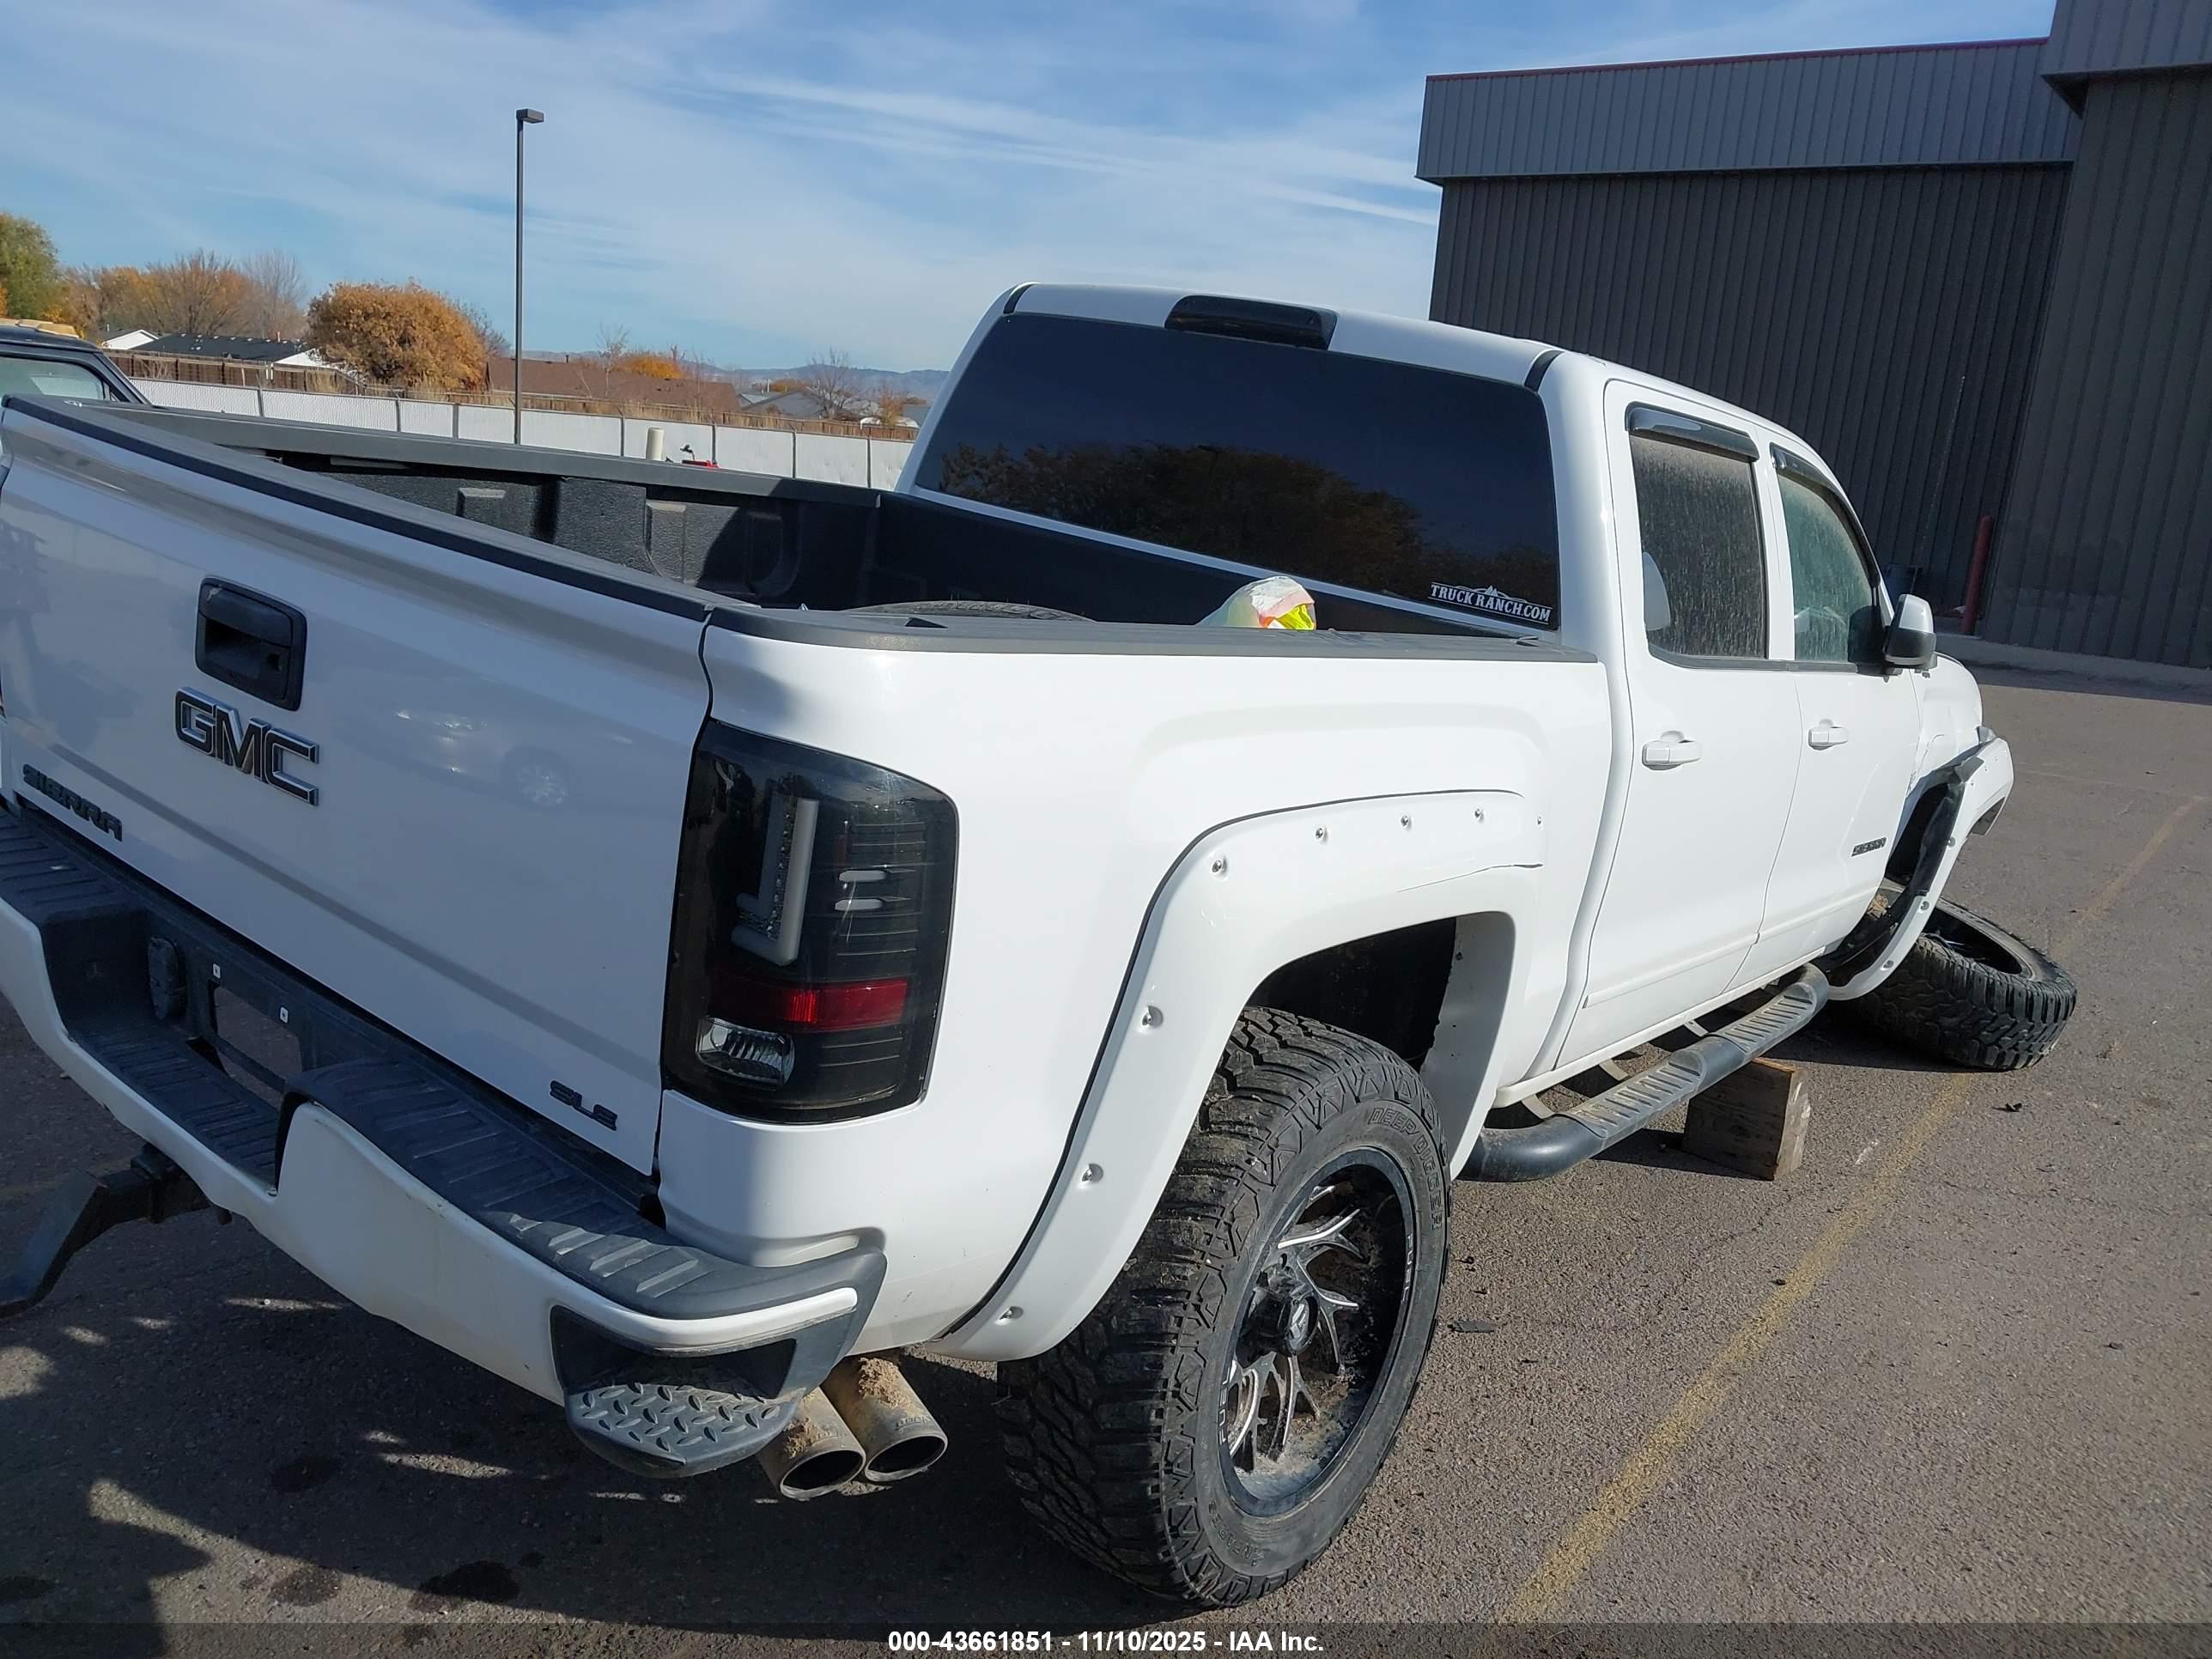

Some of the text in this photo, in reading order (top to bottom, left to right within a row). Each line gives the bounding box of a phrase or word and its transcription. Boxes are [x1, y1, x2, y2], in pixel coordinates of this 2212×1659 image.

[1431, 584, 1552, 622] TRUCK RANCH.COM
[174, 687, 319, 805] GMC
[22, 763, 123, 842] SIERRA
[550, 1080, 618, 1131] SLE
